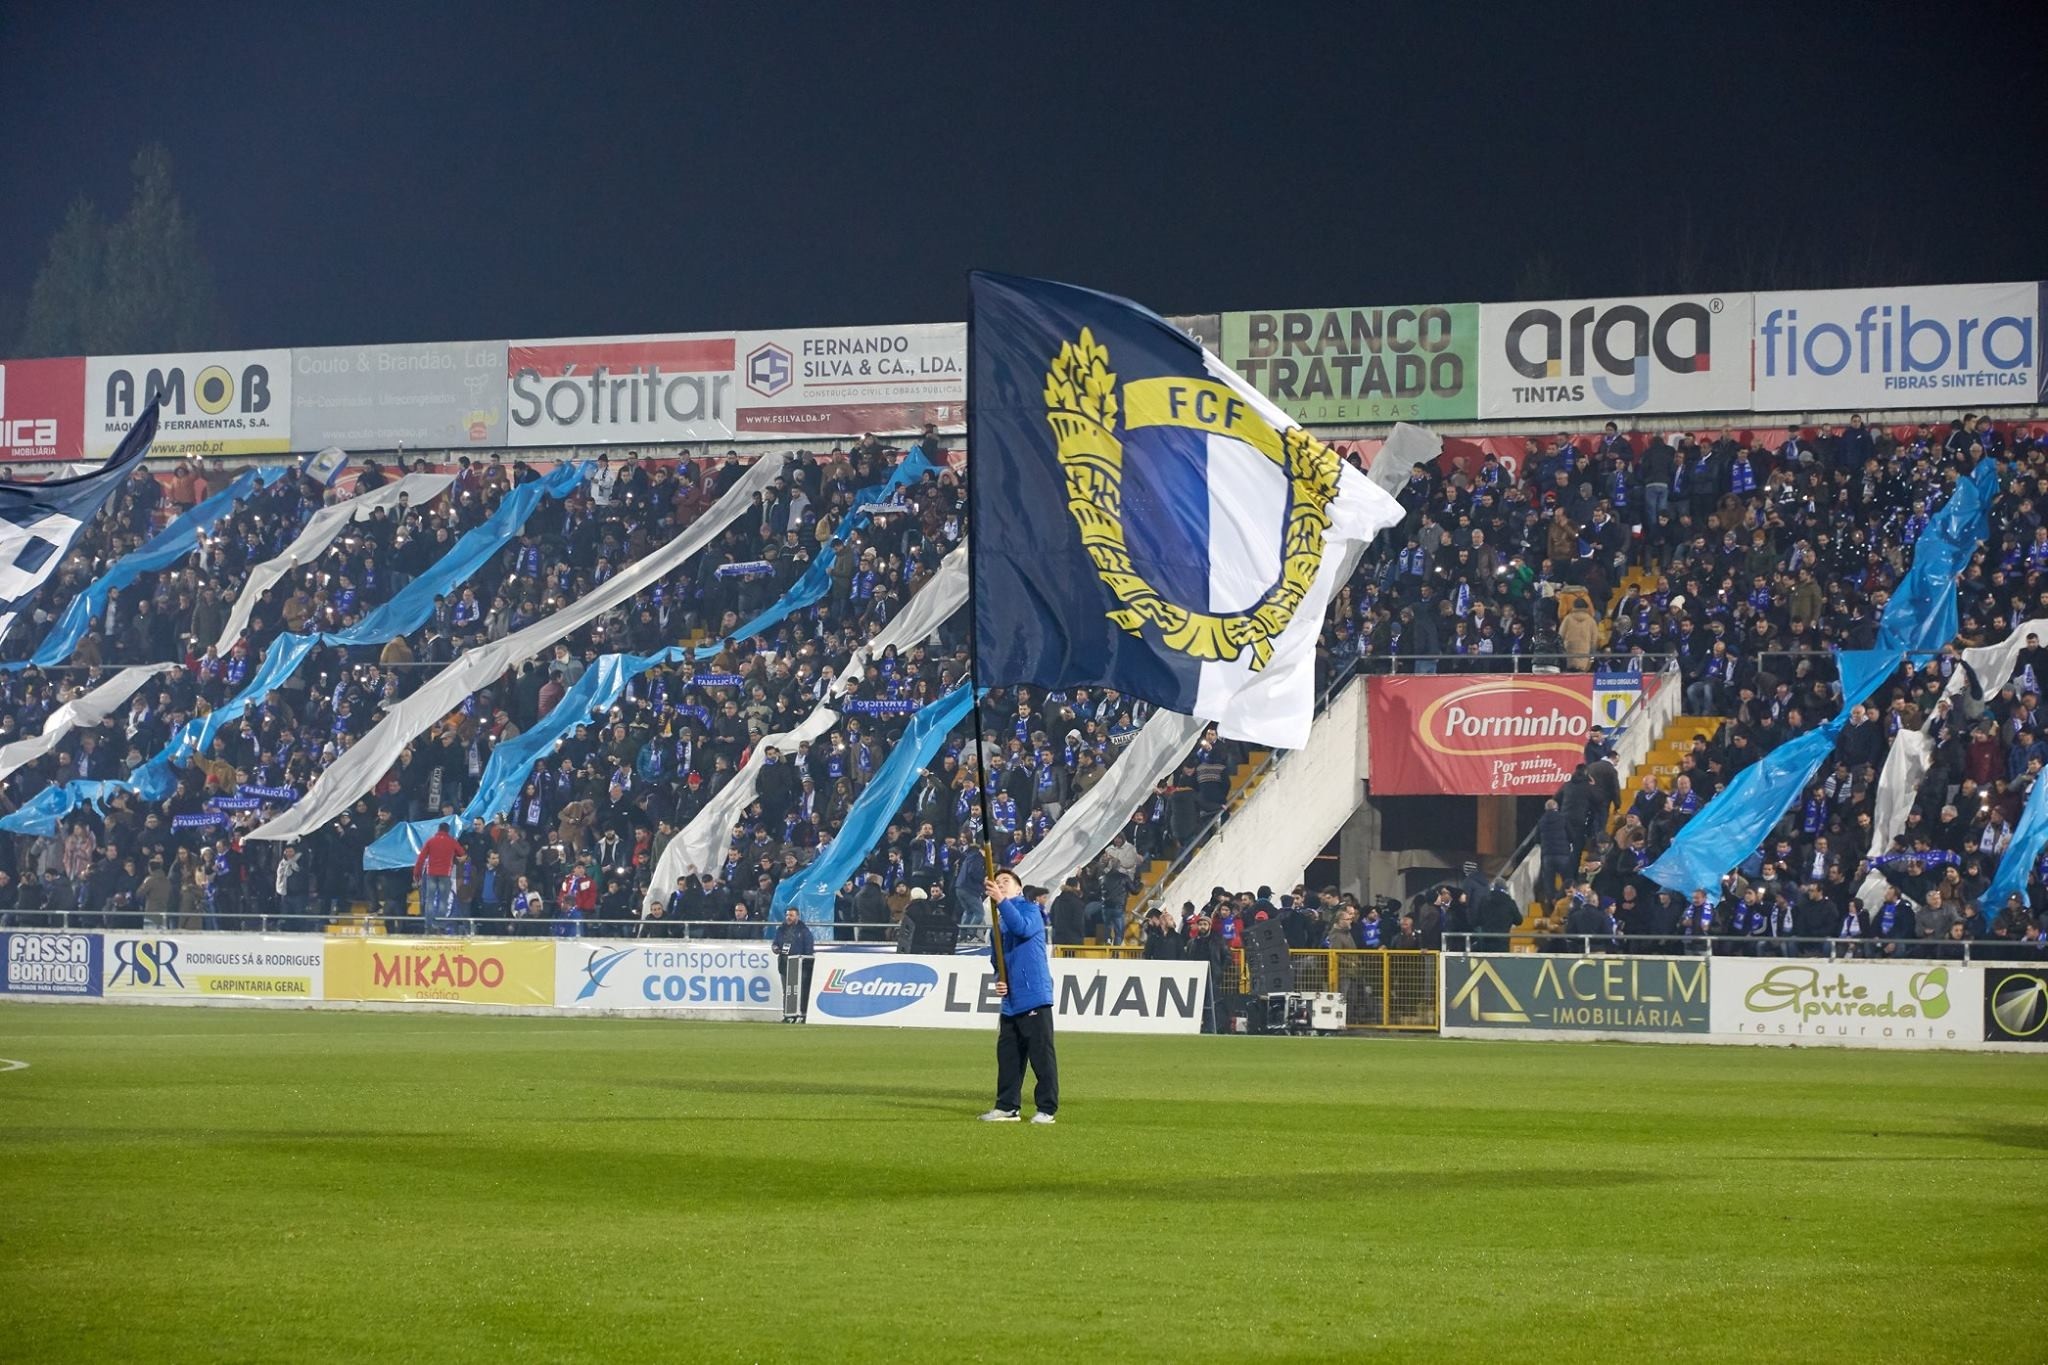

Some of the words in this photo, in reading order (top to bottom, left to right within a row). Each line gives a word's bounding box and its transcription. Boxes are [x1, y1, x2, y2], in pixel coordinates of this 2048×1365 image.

[1248, 306, 1452, 358] BRANCO
[1760, 305, 2033, 377] fiofibra
[803, 336, 909, 356] FERNANDO
[1504, 301, 1712, 411] arga
[299, 354, 350, 374] Couto
[357, 352, 370, 372] &
[464, 349, 503, 368] Lda.
[803, 359, 853, 377] SILVA
[859, 358, 872, 375] &
[920, 356, 963, 373] LDA.
[1235, 351, 1463, 402] TRATADO
[1884, 374, 1939, 391] FIBRAS
[1941, 370, 2028, 388] SINTÉTICAS
[106, 364, 271, 417] AMOB
[511, 364, 730, 427] Sófritar
[803, 387, 858, 398] CONSTRUÇÃO
[860, 387, 883, 397] CIVIL
[885, 387, 890, 396] E
[892, 386, 920, 395] OBRAS
[1511, 385, 1585, 403] TINTAS
[745, 413, 831, 424] WWW.FSILVALDA.PT
[1168, 386, 1245, 429] FCF
[1283, 404, 1420, 419] ADEIRAS
[164, 418, 246, 431] FERRAMENTAS,
[249, 417, 270, 428] S.A.
[150, 441, 224, 454] www.amob.pt
[1445, 706, 1587, 738] Porminho
[1493, 760, 1518, 774] Por
[1520, 755, 1558, 770] mim,
[1502, 767, 1573, 788] Porminho
[245, 786, 290, 799] FAMALICÃO
[177, 816, 221, 826] FAMALICÃO
[9, 934, 90, 963] FASSA
[186, 953, 243, 965] RODRIGUES
[243, 952, 254, 965] SÁ
[256, 954, 263, 965] &
[265, 954, 321, 966] RODRIGUES
[643, 947, 770, 972] transportes
[9, 962, 89, 984] BORTOLO
[372, 952, 504, 989] MIKADO
[1533, 959, 1707, 1003] ACELM
[1763, 965, 1868, 999] Arte
[210, 980, 273, 992] CARPINTARIA
[275, 980, 305, 993] GERAL
[643, 970, 771, 1002] cosme
[823, 968, 934, 998] Ledman
[944, 972, 1199, 1018] LEMAN
[1744, 982, 1917, 1022] Apurada
[1553, 1005, 1684, 1027] IMOBILIÁRIA
[1739, 1020, 1957, 1040] restaurante
